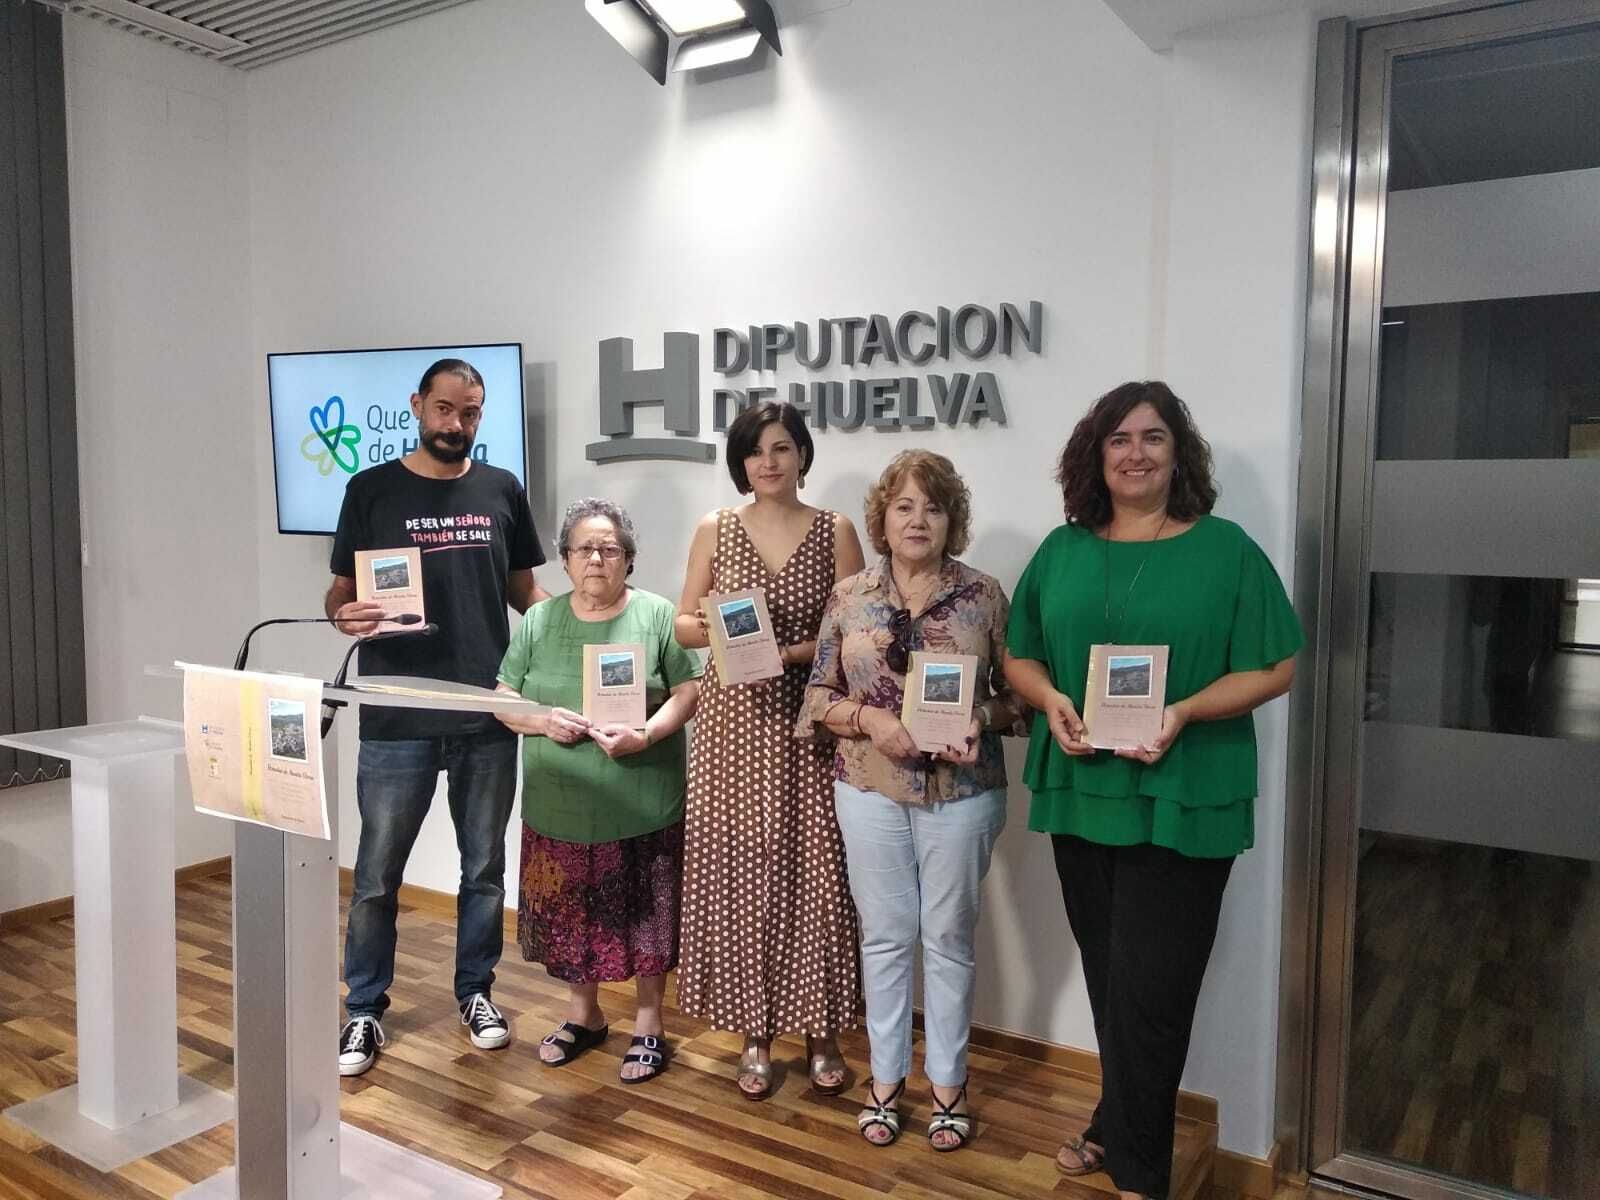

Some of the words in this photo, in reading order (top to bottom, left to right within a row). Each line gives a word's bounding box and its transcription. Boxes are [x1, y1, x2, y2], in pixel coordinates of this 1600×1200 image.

[713, 300, 1042, 375] DIPUTACION
[599, 331, 700, 437] H
[788, 372, 1007, 434] HUELVA
[366, 404, 411, 434] Que
[368, 437, 395, 463] de
[405, 519, 421, 530] DE
[420, 517, 439, 529] SER
[440, 516, 454, 527] UN
[455, 513, 492, 527] SEÑORO
[410, 529, 454, 543] TAMBIÉN
[455, 531, 468, 541] SE
[469, 530, 492, 541] SALE
